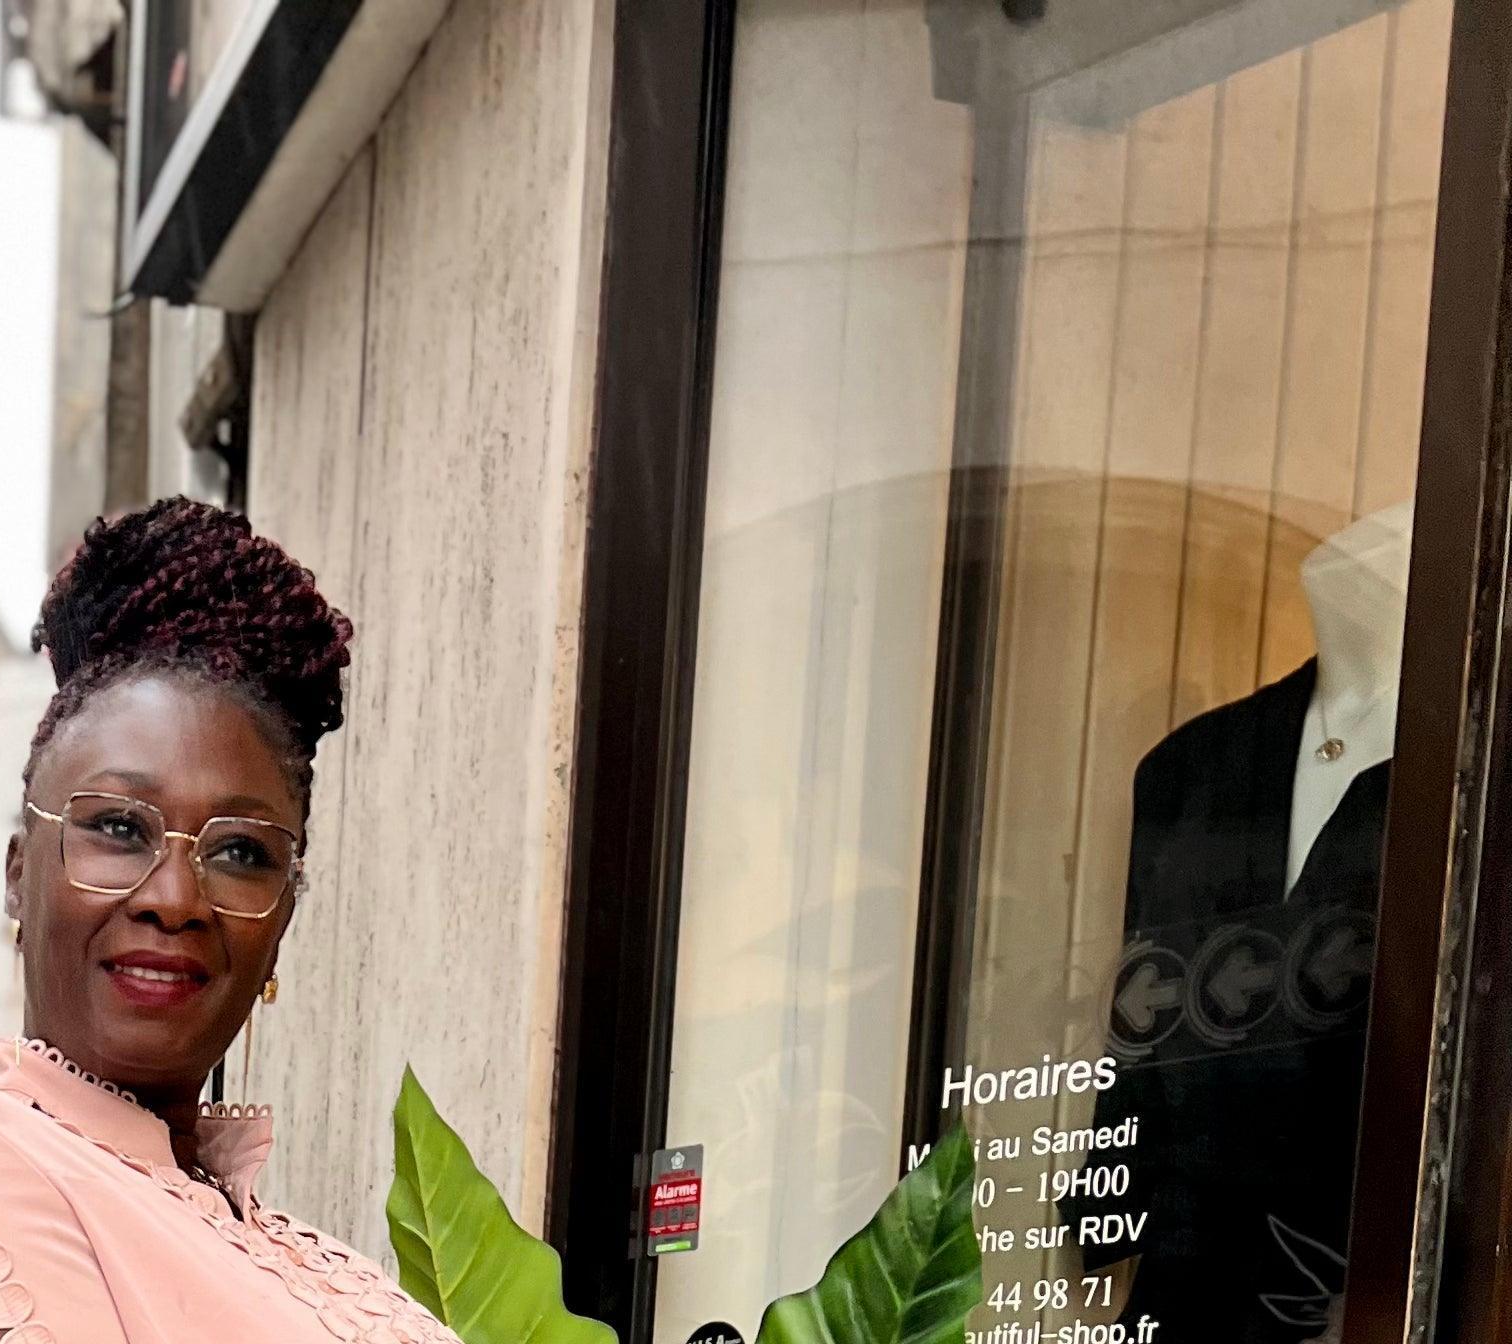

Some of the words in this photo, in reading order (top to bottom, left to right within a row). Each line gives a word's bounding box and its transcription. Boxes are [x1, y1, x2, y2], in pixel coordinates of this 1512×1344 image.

[941, 1054, 1117, 1109] Horaires
[987, 1136, 1021, 1161] au
[1031, 1116, 1139, 1156] Samedi
[654, 1183, 698, 1200] Alarme
[1037, 1164, 1130, 1202] 19H00
[1024, 1225, 1070, 1250] sur
[1079, 1211, 1148, 1246] RDV
[987, 1281, 1022, 1313] 44
[1033, 1278, 1069, 1311] 98
[1081, 1275, 1112, 1307] 71
